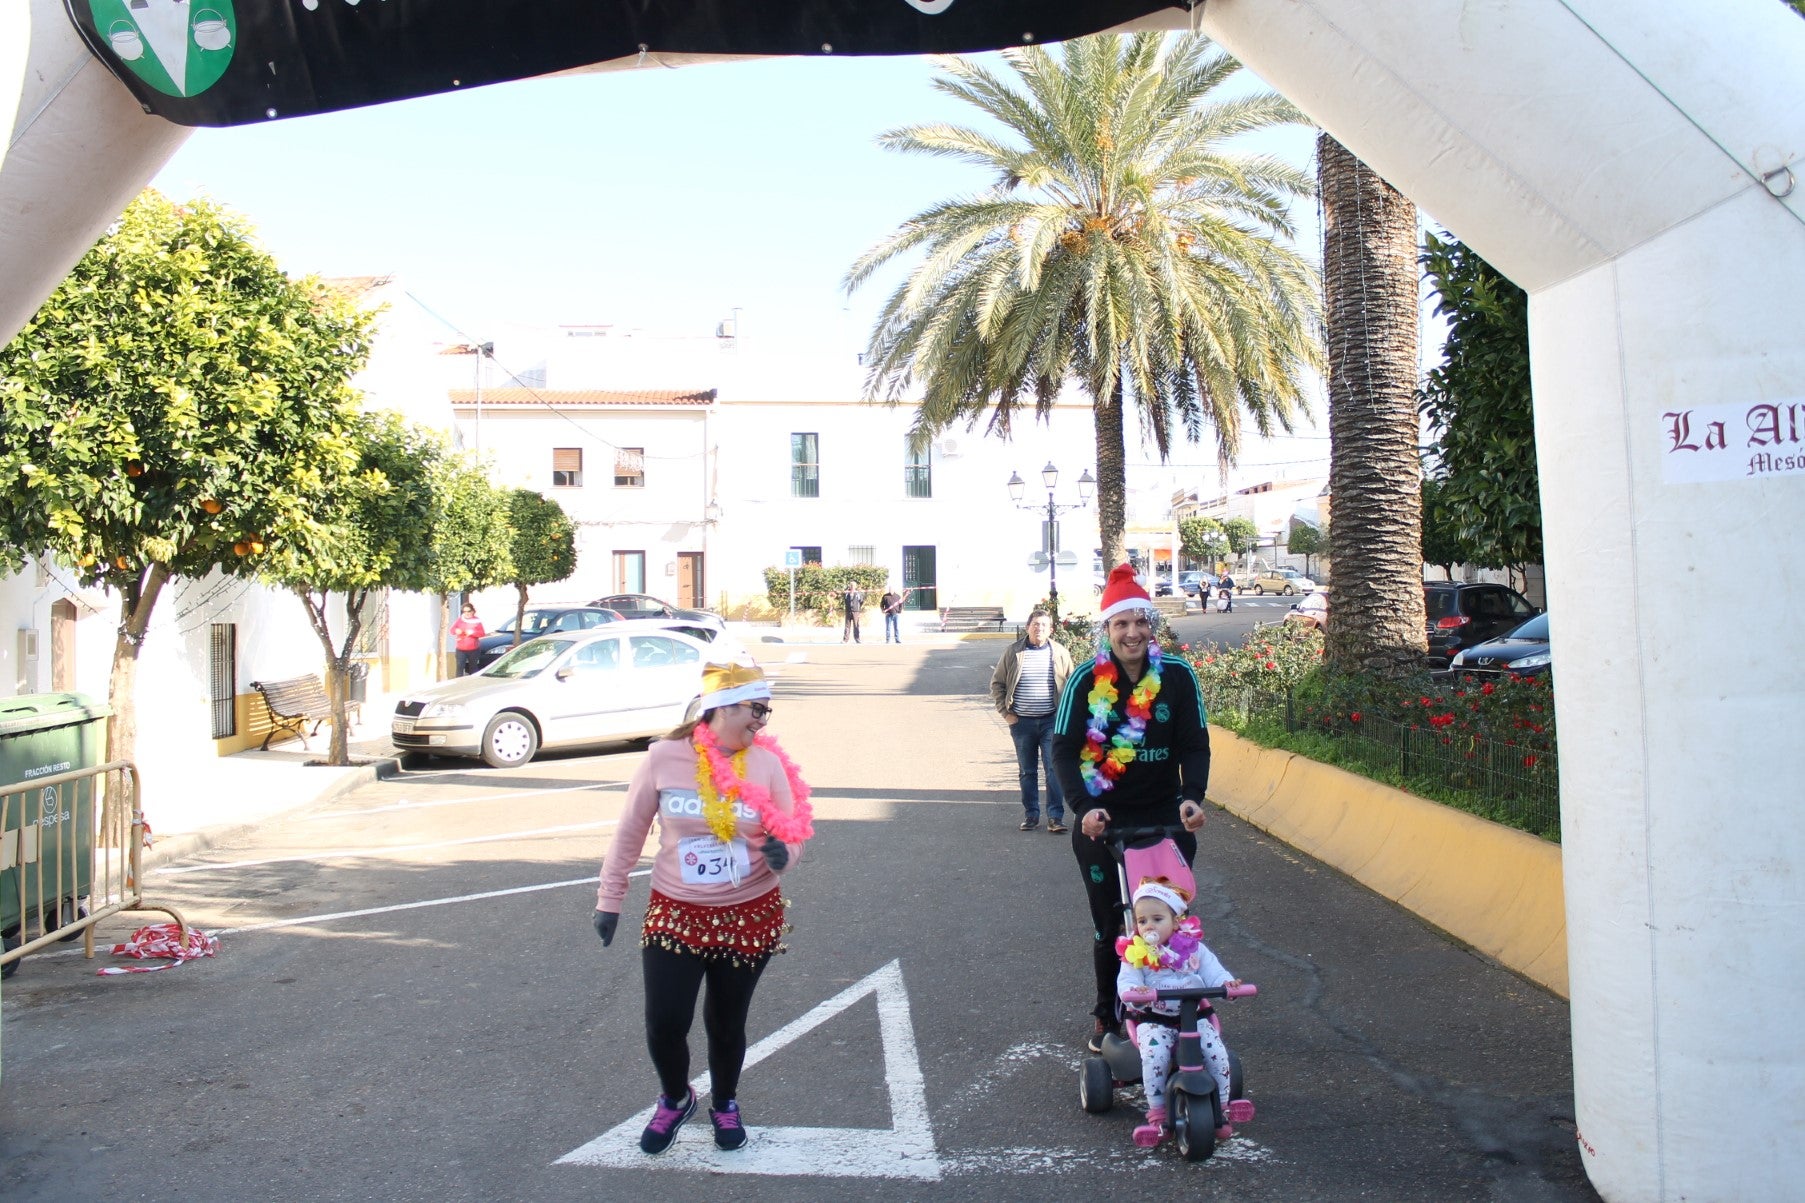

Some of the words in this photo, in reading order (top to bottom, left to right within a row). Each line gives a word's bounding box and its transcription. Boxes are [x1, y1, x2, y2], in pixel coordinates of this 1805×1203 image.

[1662, 410, 1728, 453] La
[1746, 447, 1805, 476] Mesó
[25, 764, 52, 778] FRACCIÓN
[53, 761, 70, 772] RESTO
